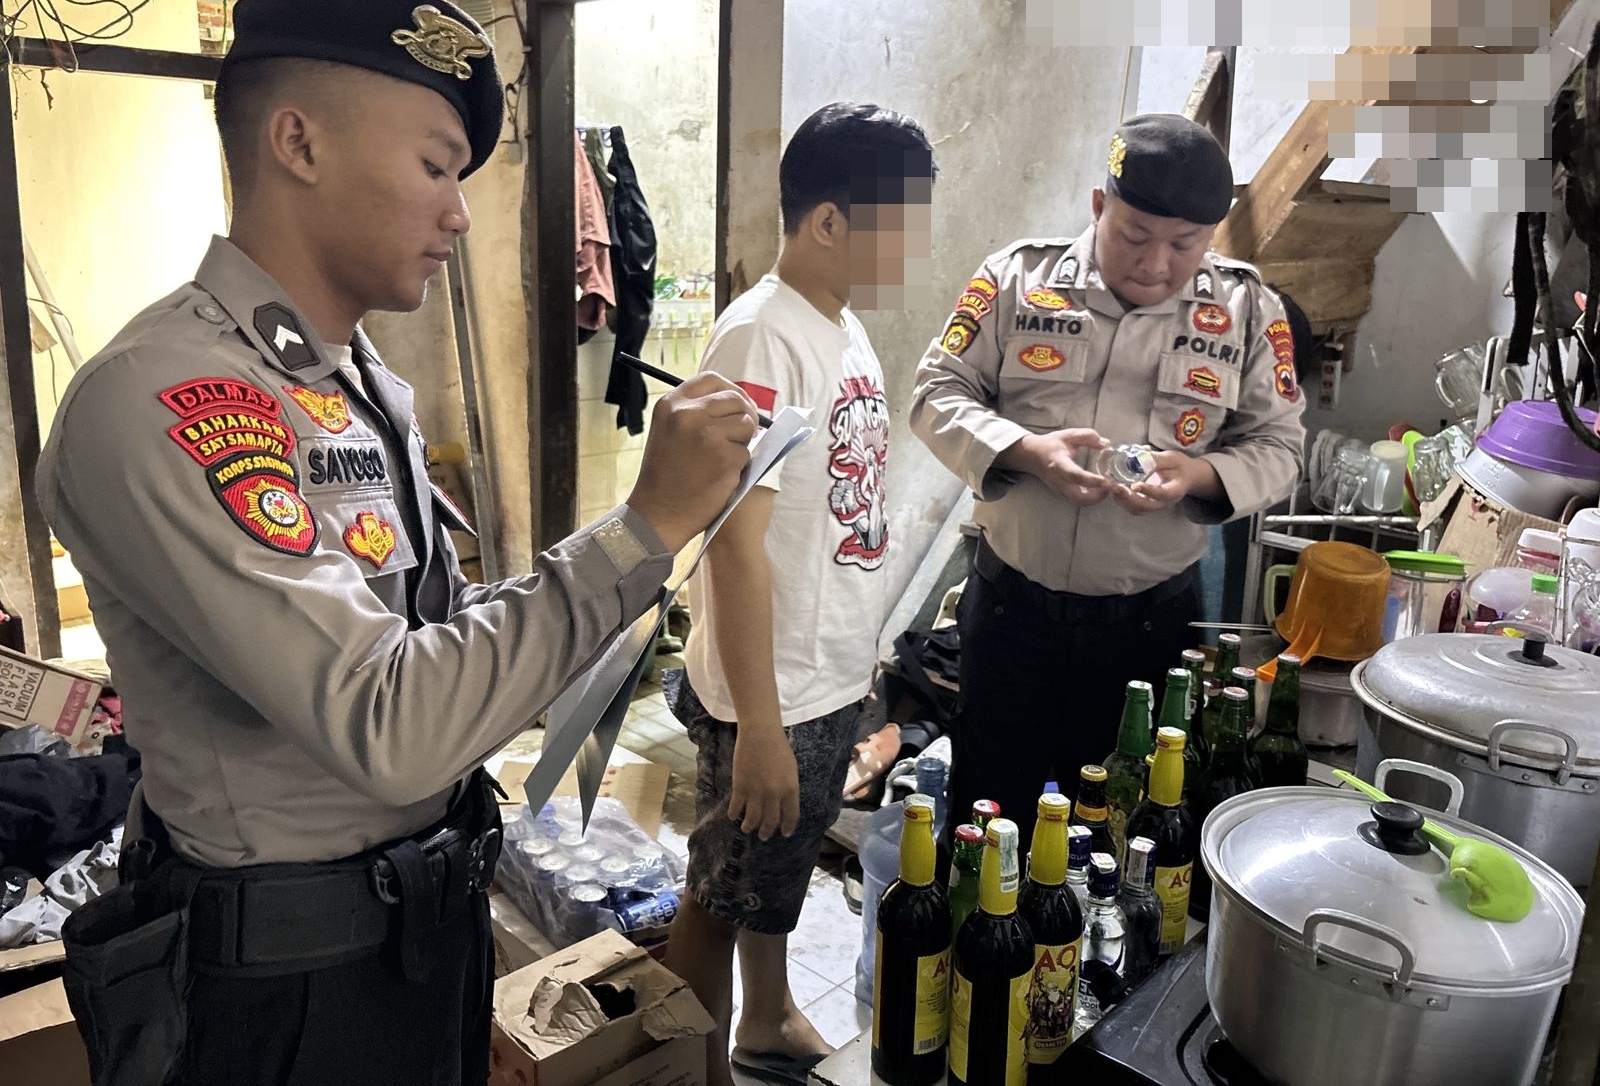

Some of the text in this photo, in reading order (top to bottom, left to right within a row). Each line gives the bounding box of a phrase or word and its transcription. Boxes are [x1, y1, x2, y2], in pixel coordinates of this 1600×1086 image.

[1015, 314, 1082, 335] HARTO
[1173, 335, 1240, 364] POLRI
[178, 384, 272, 408] DALMAS
[184, 414, 286, 441] BAHARKAM
[0, 665, 27, 708] FLASK
[13, 671, 41, 713] VACUUM
[1034, 944, 1077, 973] AO
